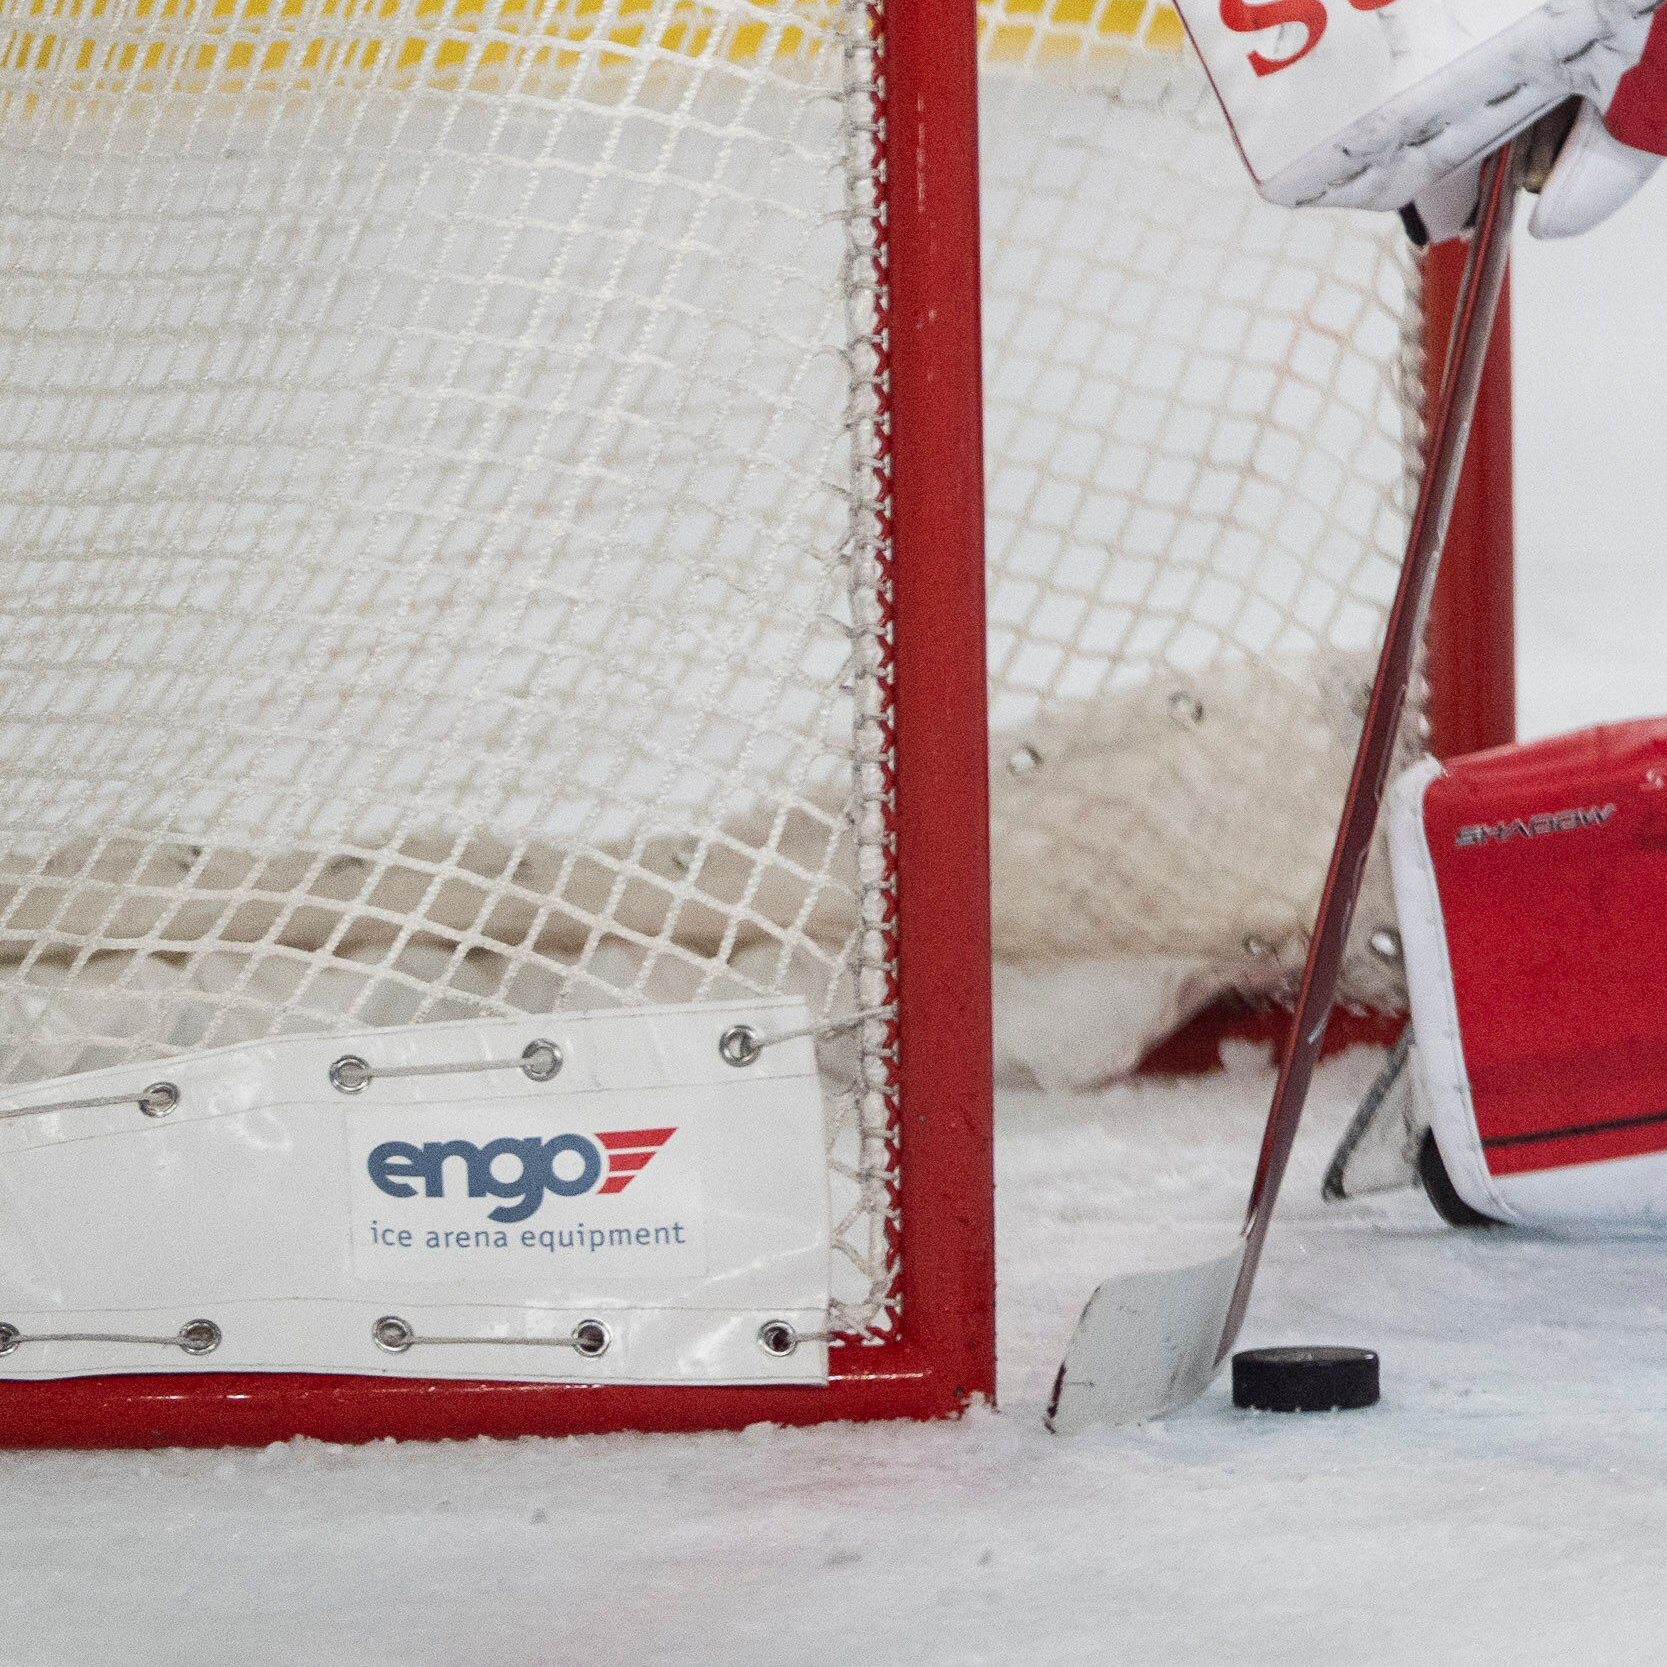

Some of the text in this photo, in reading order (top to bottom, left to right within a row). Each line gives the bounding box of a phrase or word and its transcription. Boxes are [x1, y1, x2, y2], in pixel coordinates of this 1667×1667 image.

[1456, 802, 1617, 848] SHADOW
[367, 1133, 602, 1224] engo
[371, 1220, 686, 1252] ice arena equipment
